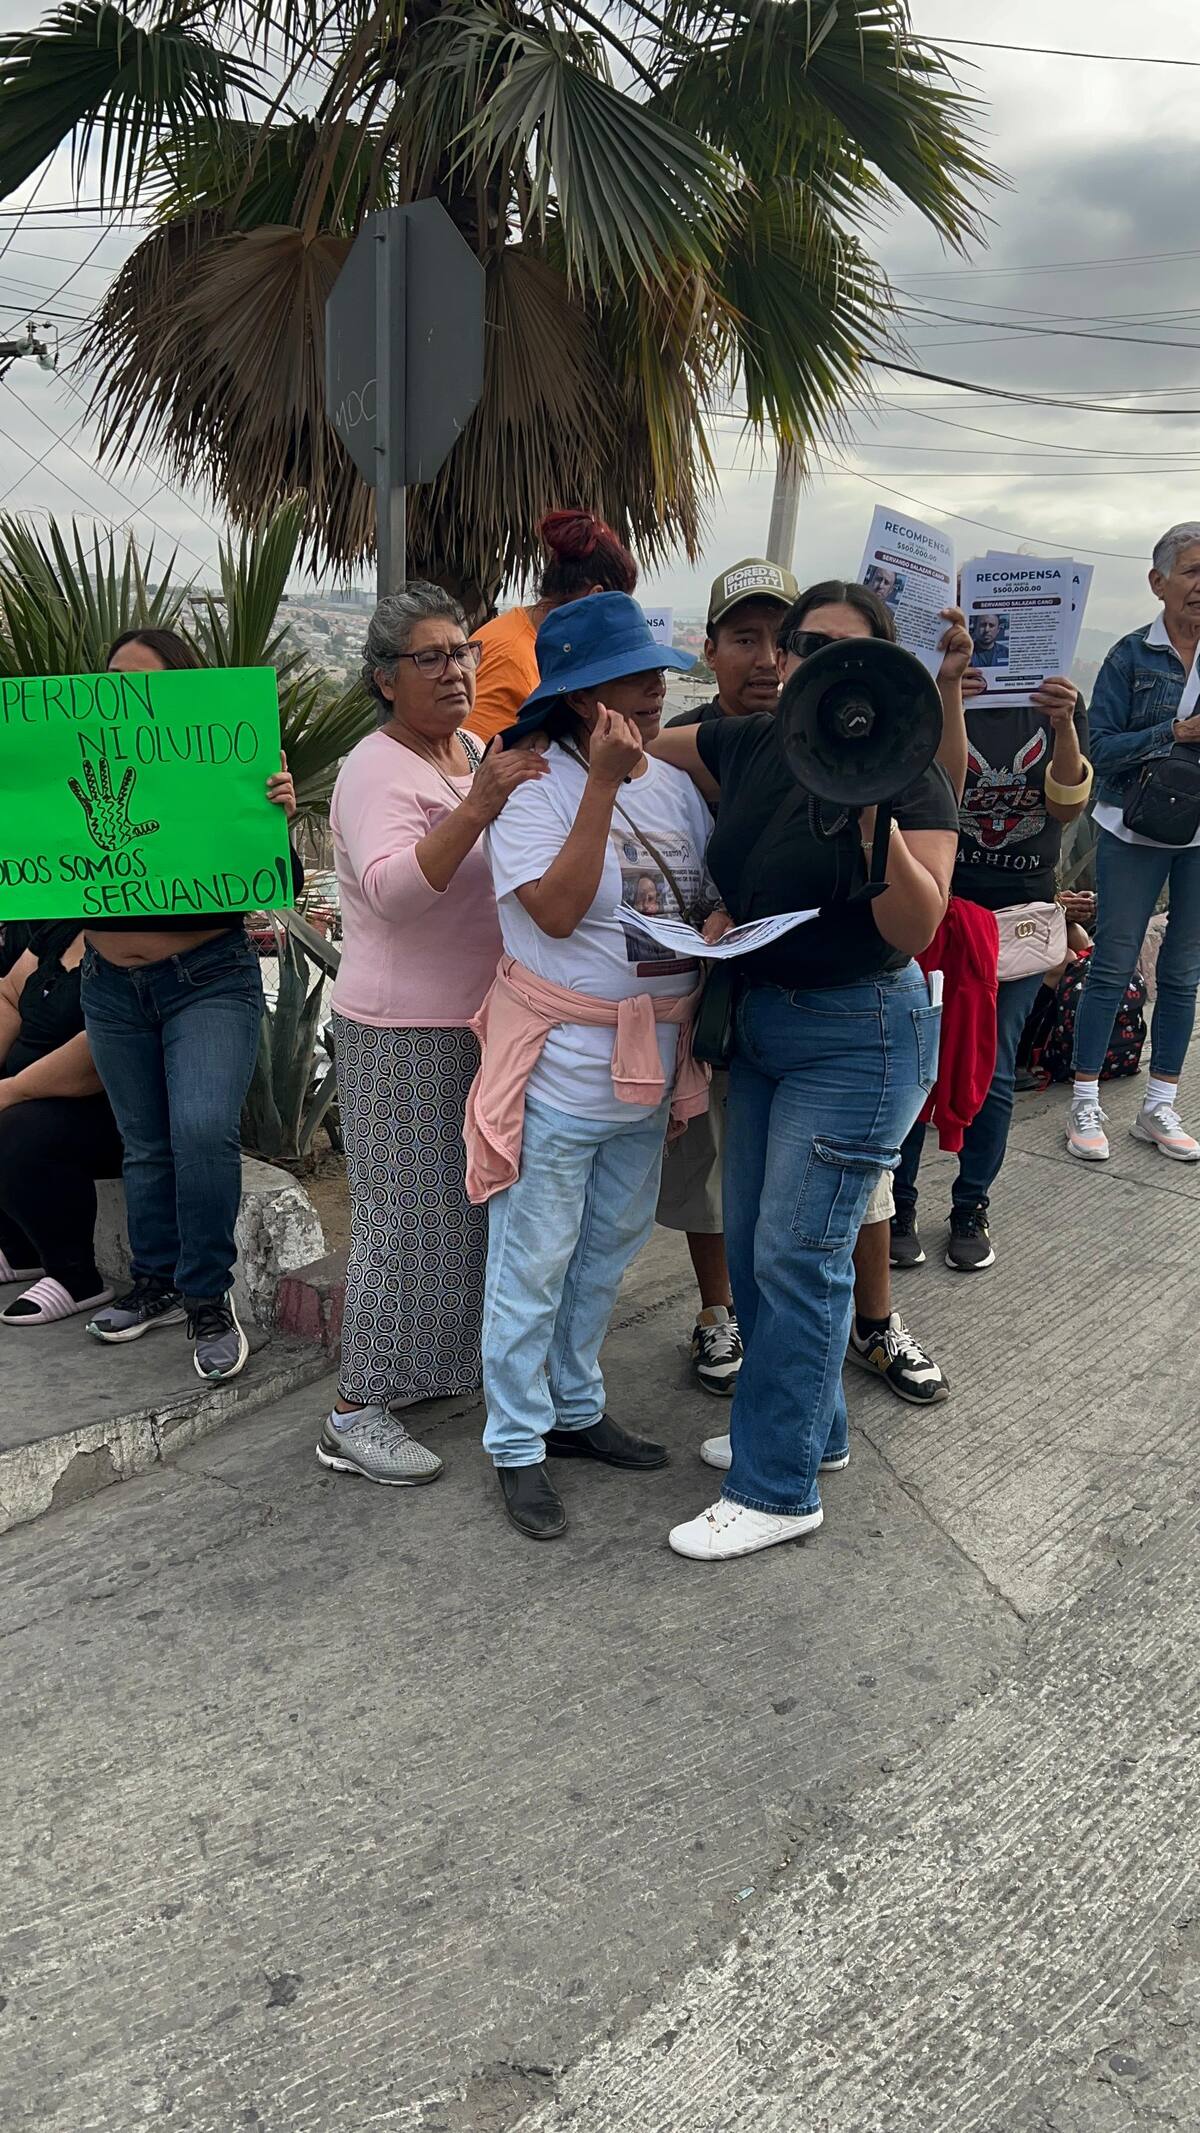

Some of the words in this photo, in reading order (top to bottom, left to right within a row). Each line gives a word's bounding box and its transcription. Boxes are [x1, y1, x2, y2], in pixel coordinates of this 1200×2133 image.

[885, 521, 951, 557] RECOMPENSA
[882, 554, 910, 568] SERVANDO
[727, 566, 767, 585] BORED
[768, 568, 778, 578] &
[728, 577, 780, 593] THIRSTY
[976, 570, 1061, 582] RECOMPENSA
[993, 586, 1041, 594] $500,000.00
[2, 674, 155, 723] PERDON
[78, 726, 128, 760] NI
[59, 848, 147, 882] SOMOS
[956, 848, 1040, 871] ASHION
